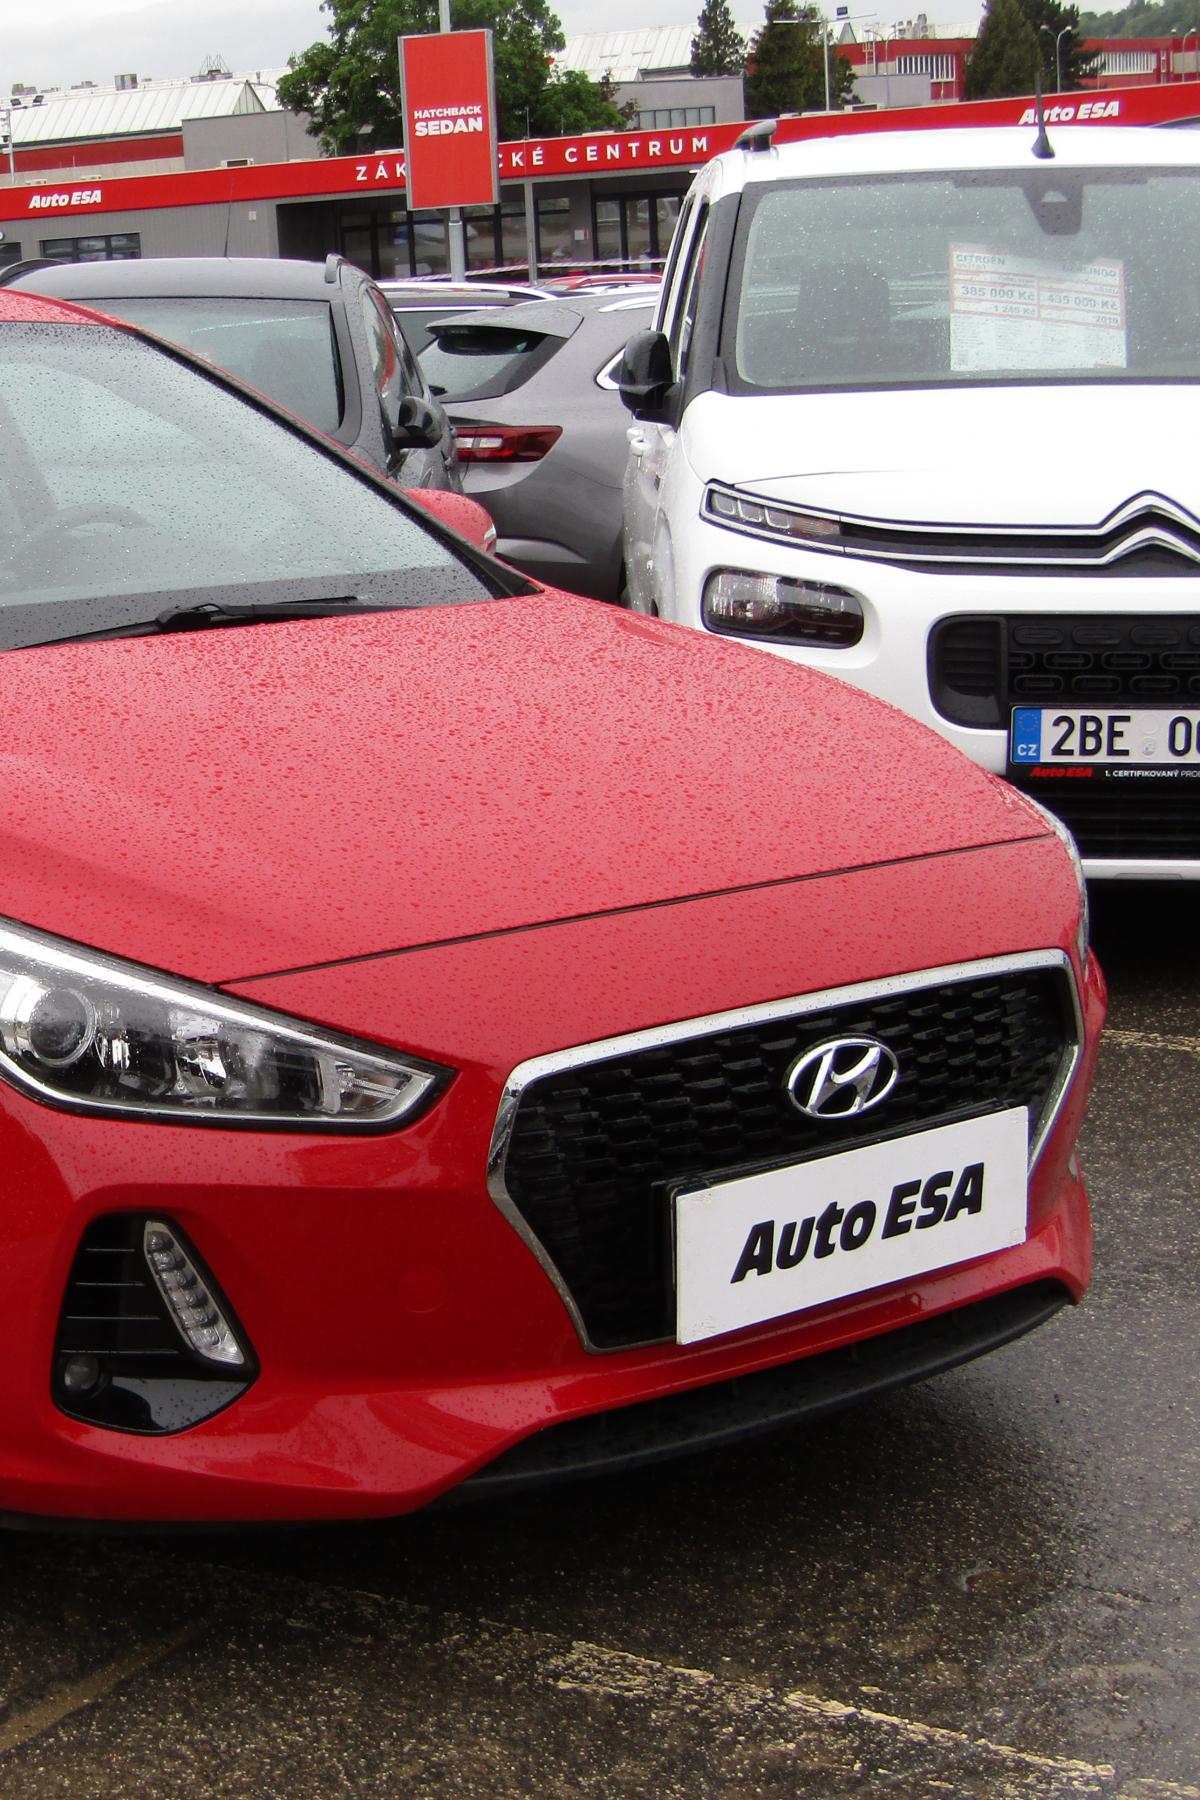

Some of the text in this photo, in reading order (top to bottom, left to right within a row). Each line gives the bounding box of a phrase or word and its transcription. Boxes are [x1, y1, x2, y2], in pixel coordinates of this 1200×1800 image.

[414, 104, 482, 119] HATCHBACK
[1018, 101, 1120, 125] Auto ESA
[414, 118, 483, 137] SEDAN
[565, 136, 708, 164] CENTRUM
[28, 190, 102, 209] Auto ESA
[961, 286, 986, 297] 385
[990, 288, 1014, 299] 000
[1074, 296, 1096, 308] 000
[1017, 715, 1200, 757] CZ 2BE 0
[1030, 767, 1065, 777] Auto
[1066, 767, 1093, 777] ESA
[1113, 768, 1179, 777] CERTIFIKOVANÝ
[730, 1162, 986, 1285] Auto ESA
